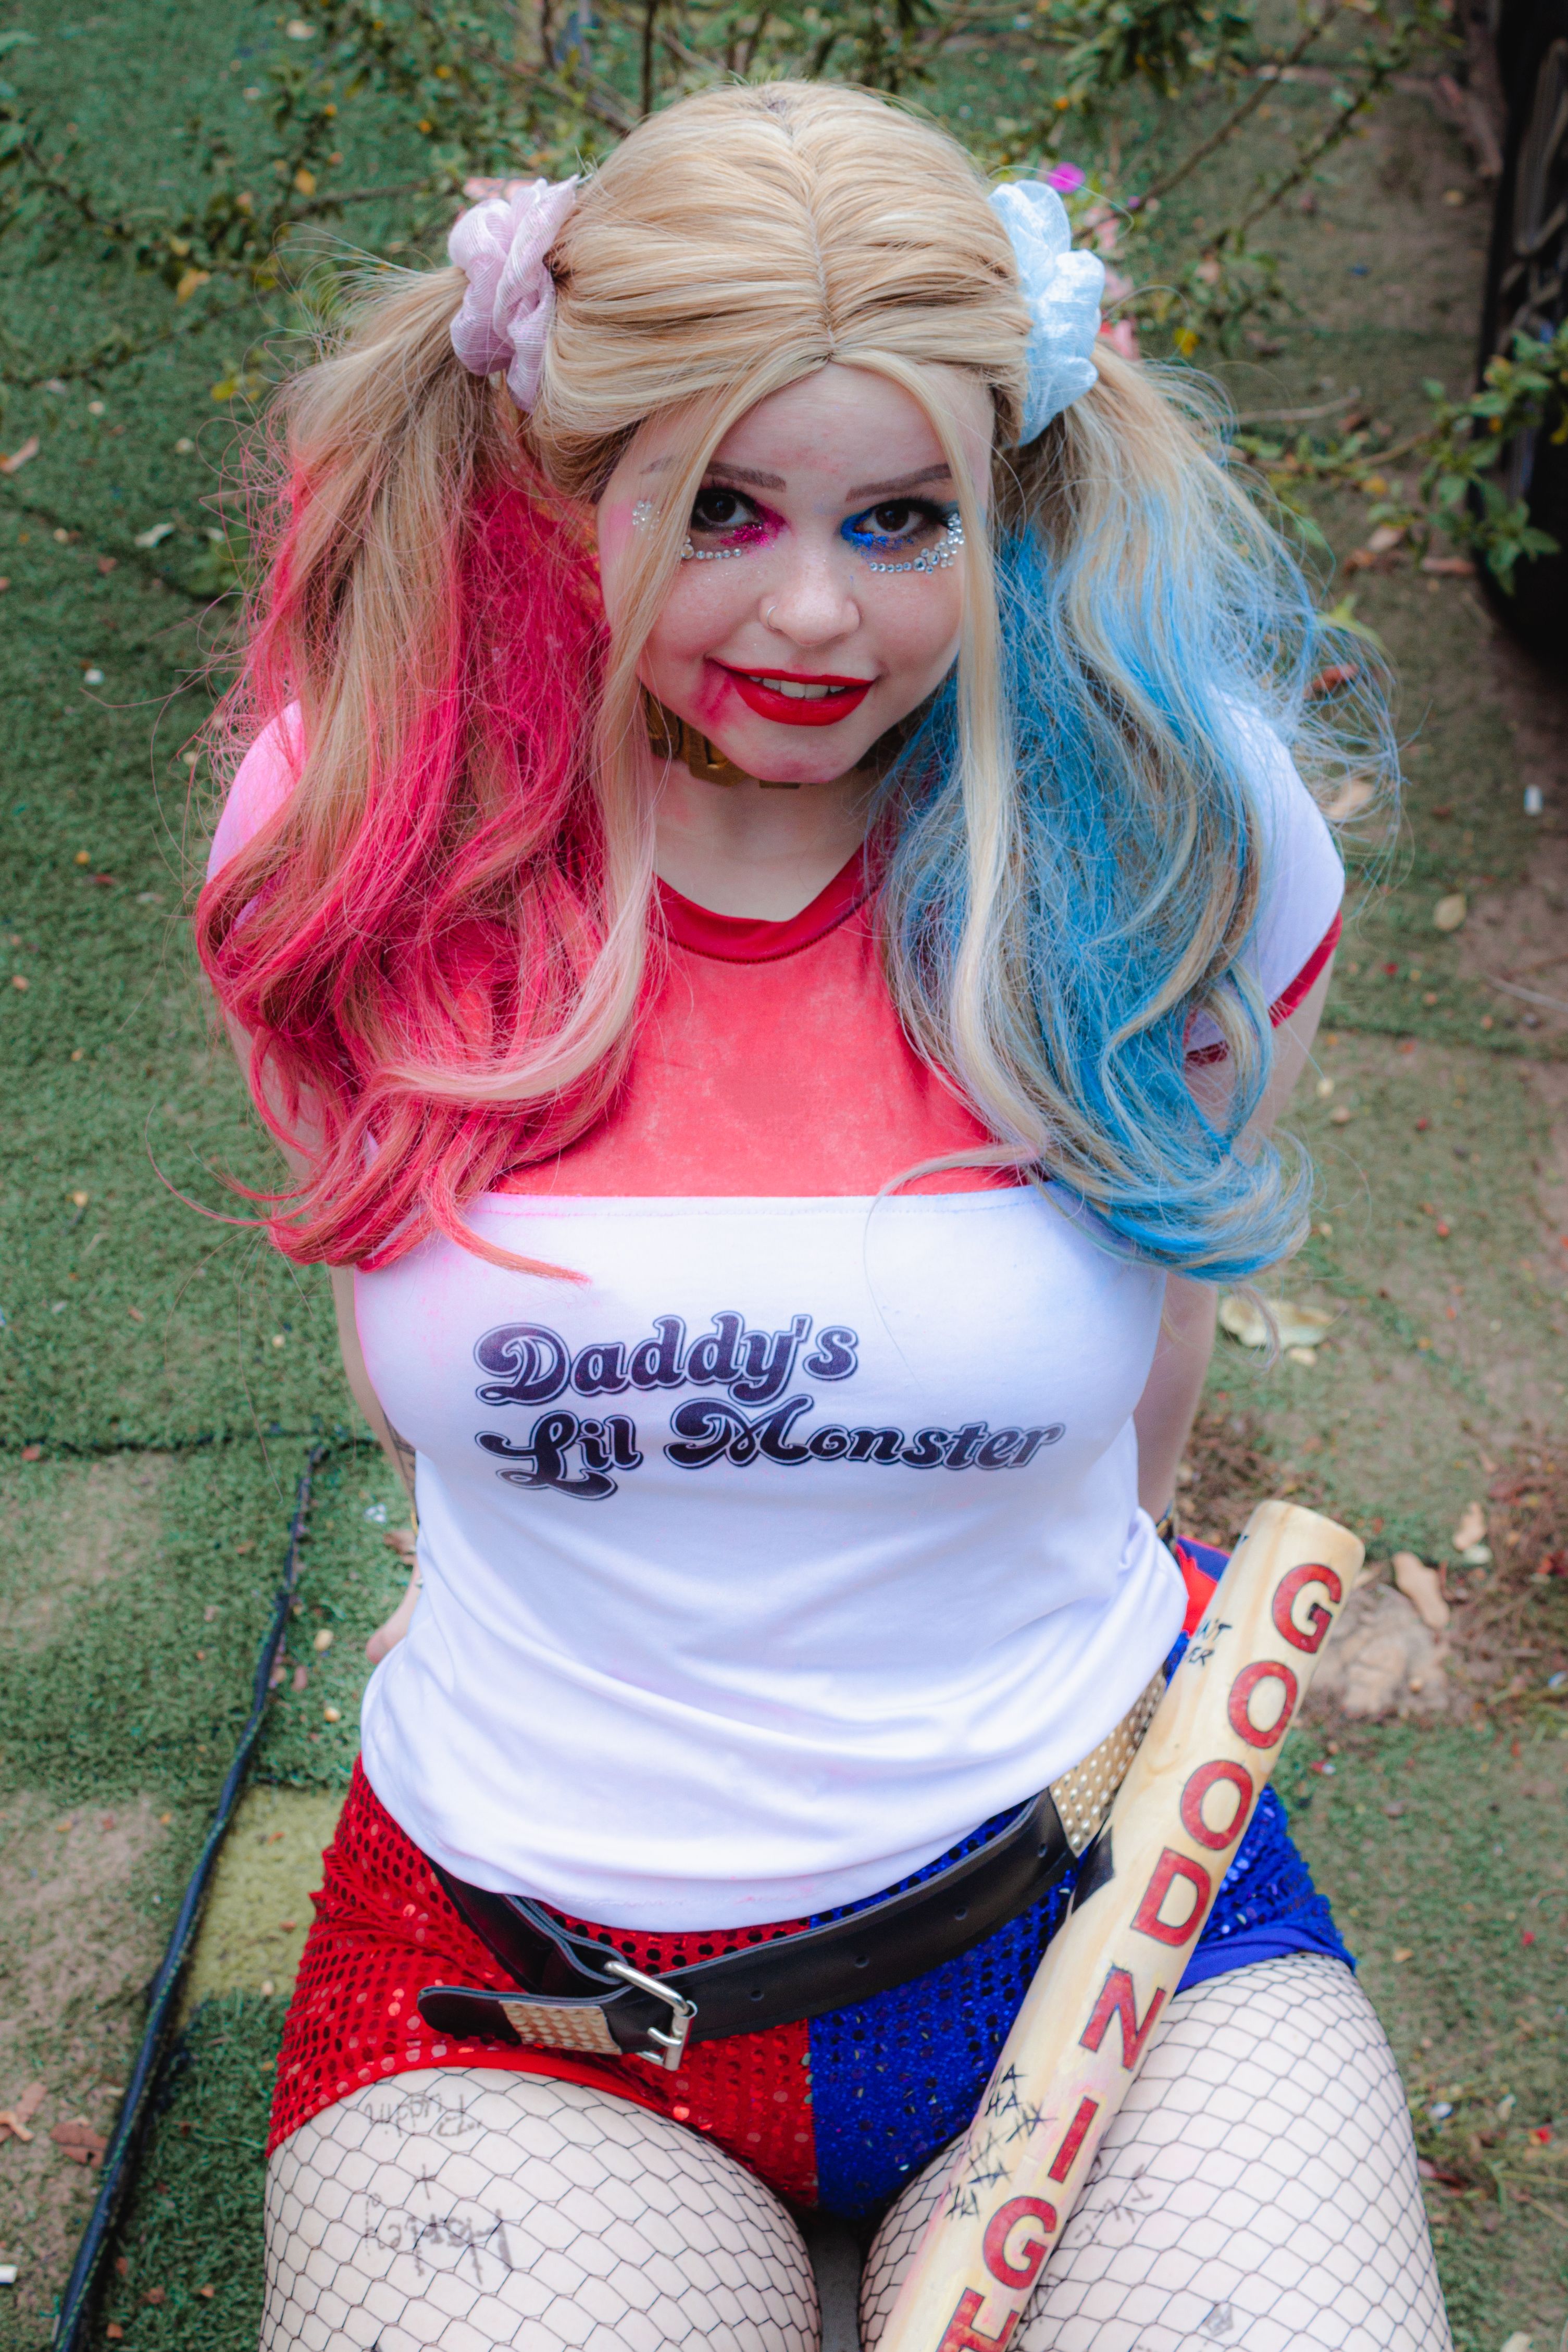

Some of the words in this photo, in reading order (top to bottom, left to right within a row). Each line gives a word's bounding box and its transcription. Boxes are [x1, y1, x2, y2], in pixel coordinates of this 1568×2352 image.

[474, 1311, 859, 1408] Daddy's
[475, 1410, 644, 1502] Lil
[663, 1394, 1066, 1471] Monster
